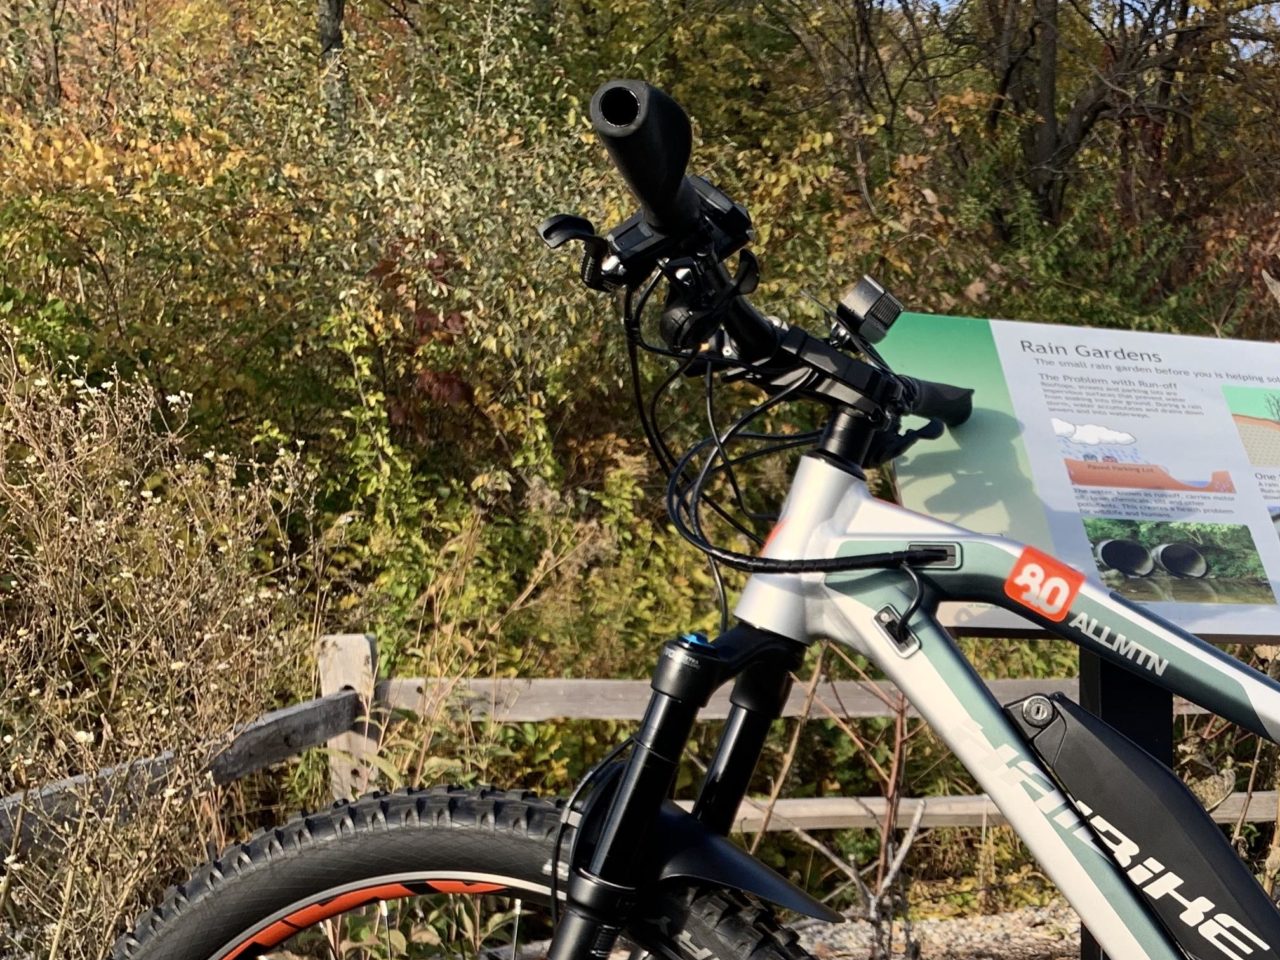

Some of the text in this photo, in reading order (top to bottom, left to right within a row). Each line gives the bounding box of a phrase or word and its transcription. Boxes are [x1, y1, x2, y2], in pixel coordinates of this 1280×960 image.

[1020, 340, 1162, 363] Rain Gardens
[1034, 358, 1055, 366] The
[1059, 360, 1087, 369] small
[1115, 364, 1152, 373] garden
[1155, 367, 1189, 377] before
[1215, 371, 1223, 379] is
[1226, 372, 1264, 383] helping
[1039, 373, 1177, 389] The Problem with Run-off
[1255, 472, 1276, 480] One
[1068, 611, 1169, 677] ALLMTN
